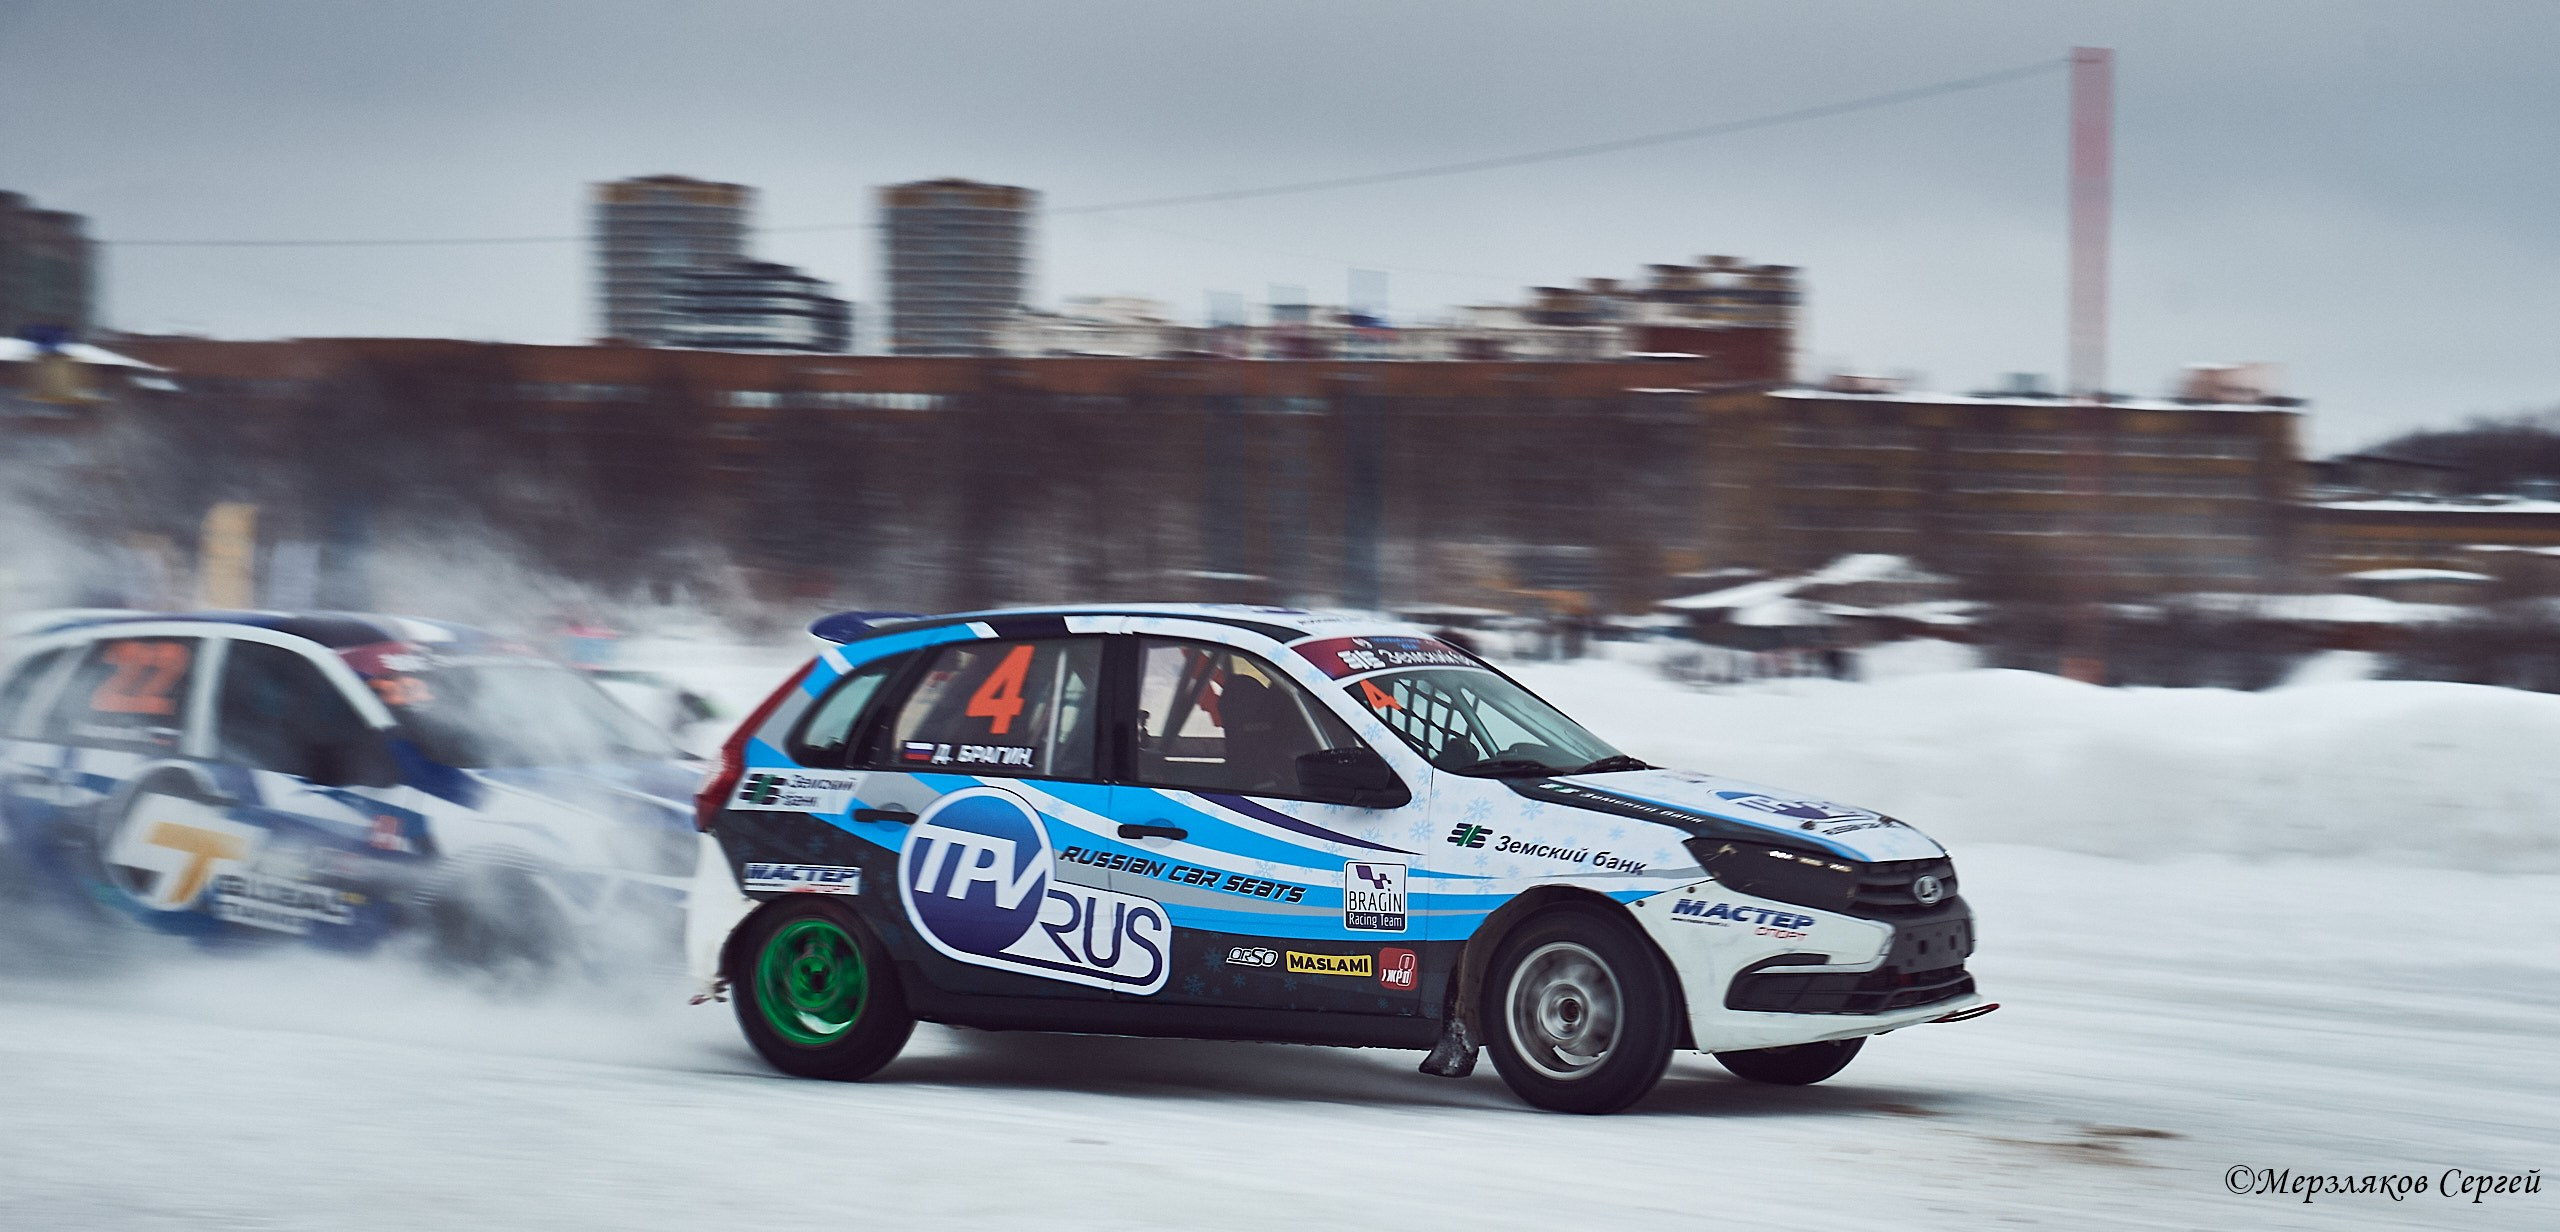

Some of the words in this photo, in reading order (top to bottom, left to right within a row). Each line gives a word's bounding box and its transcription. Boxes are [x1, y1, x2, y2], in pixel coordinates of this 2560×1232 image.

[965, 644, 1035, 734] 4
[1360, 678, 1402, 711] 4
[1495, 835, 1589, 863] Земский
[1593, 851, 1647, 875] банк
[1059, 846, 1168, 878] RUSSIAN
[1168, 864, 1222, 888] CAR
[1223, 874, 1308, 904] SEATS
[1349, 912, 1378, 929] Racing
[1380, 914, 1403, 927] Team
[1671, 898, 1816, 930] МАСТЕР
[1040, 888, 1162, 987] RUS
[1289, 954, 1369, 973] MASLAMI
